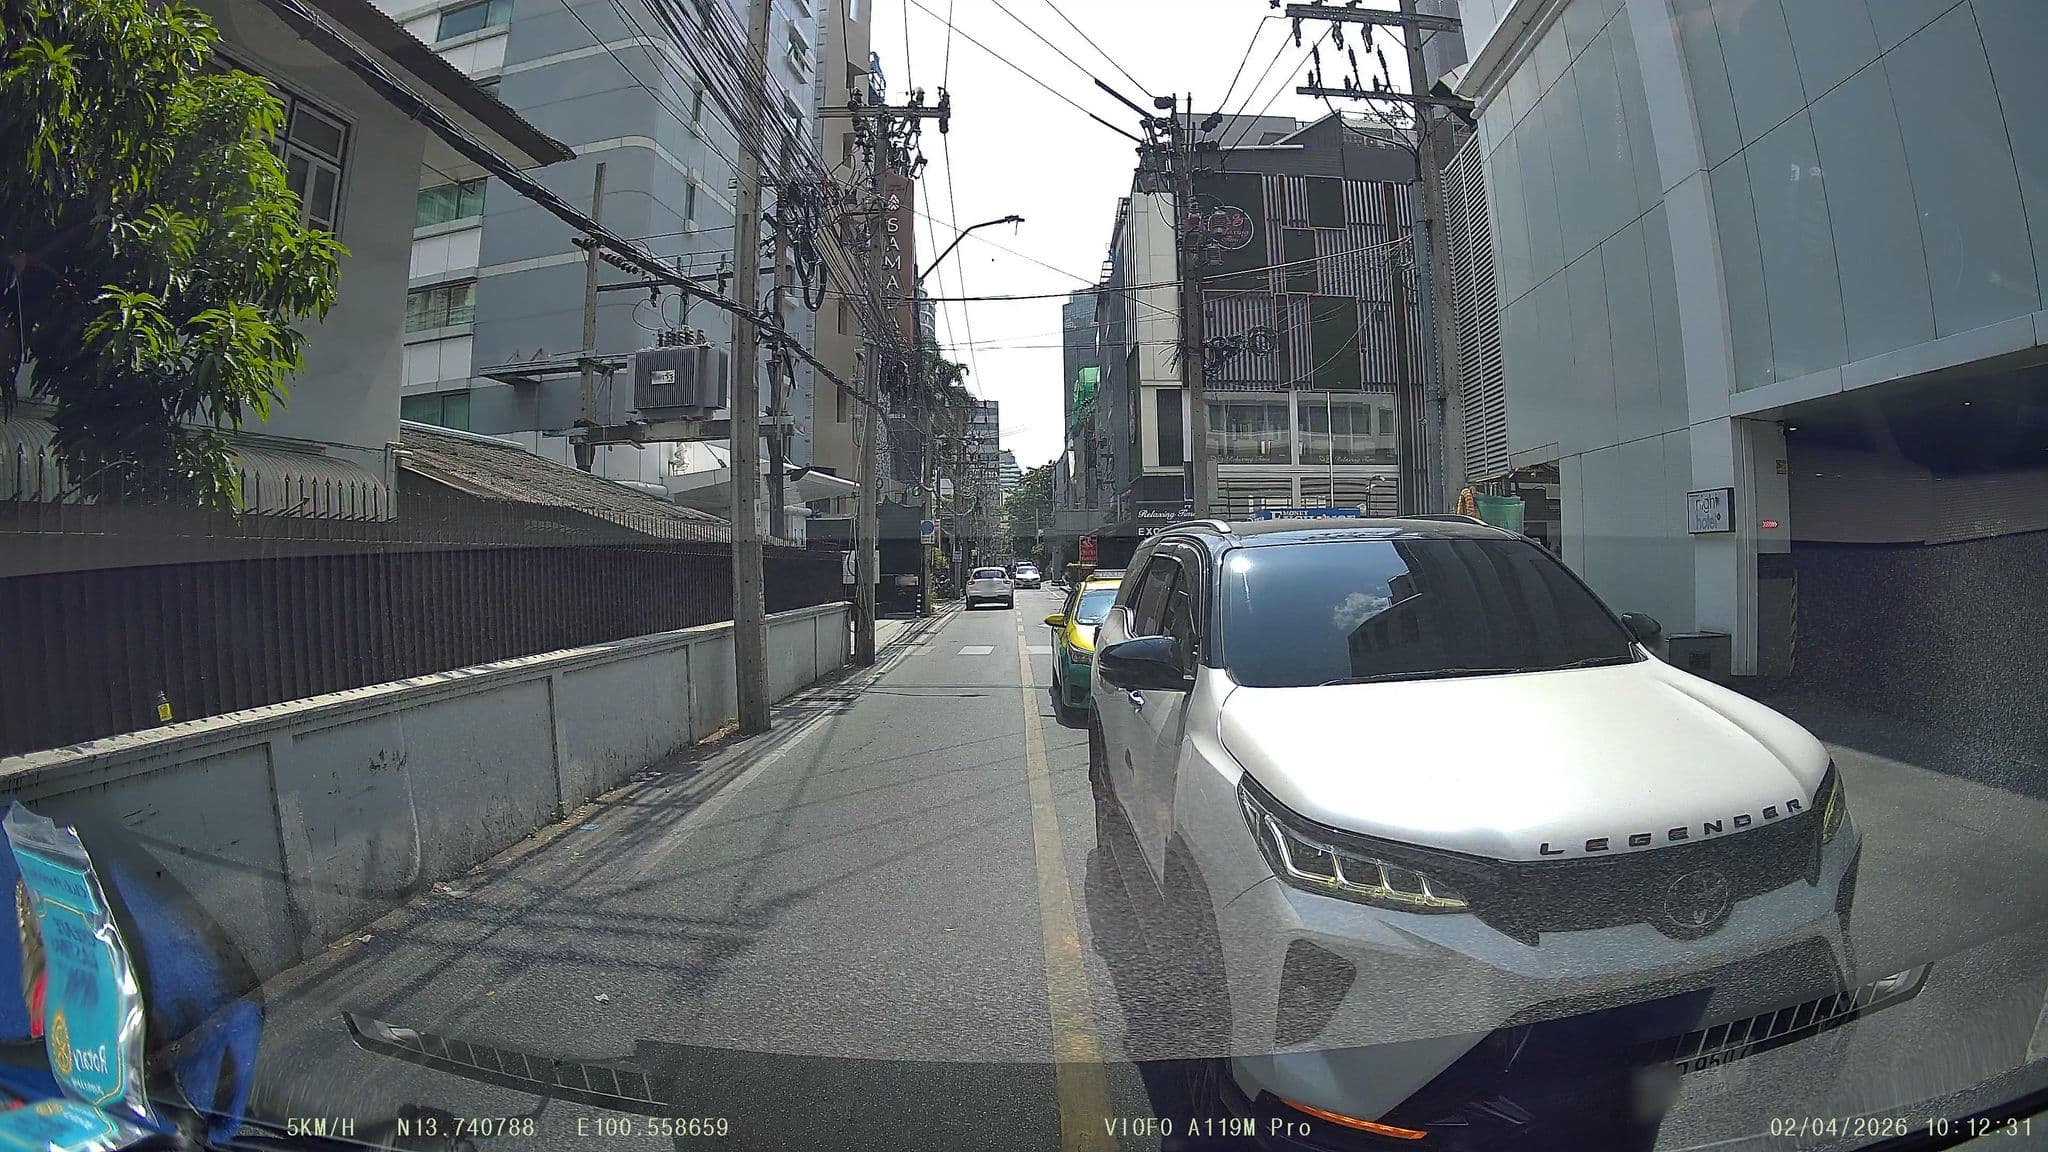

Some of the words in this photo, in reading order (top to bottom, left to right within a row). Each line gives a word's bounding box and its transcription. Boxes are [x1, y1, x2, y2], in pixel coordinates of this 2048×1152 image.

[1137, 509, 1175, 521] Relaxing
[1696, 513, 1718, 530] hotel
[1540, 798, 1802, 856] LEGENDER
